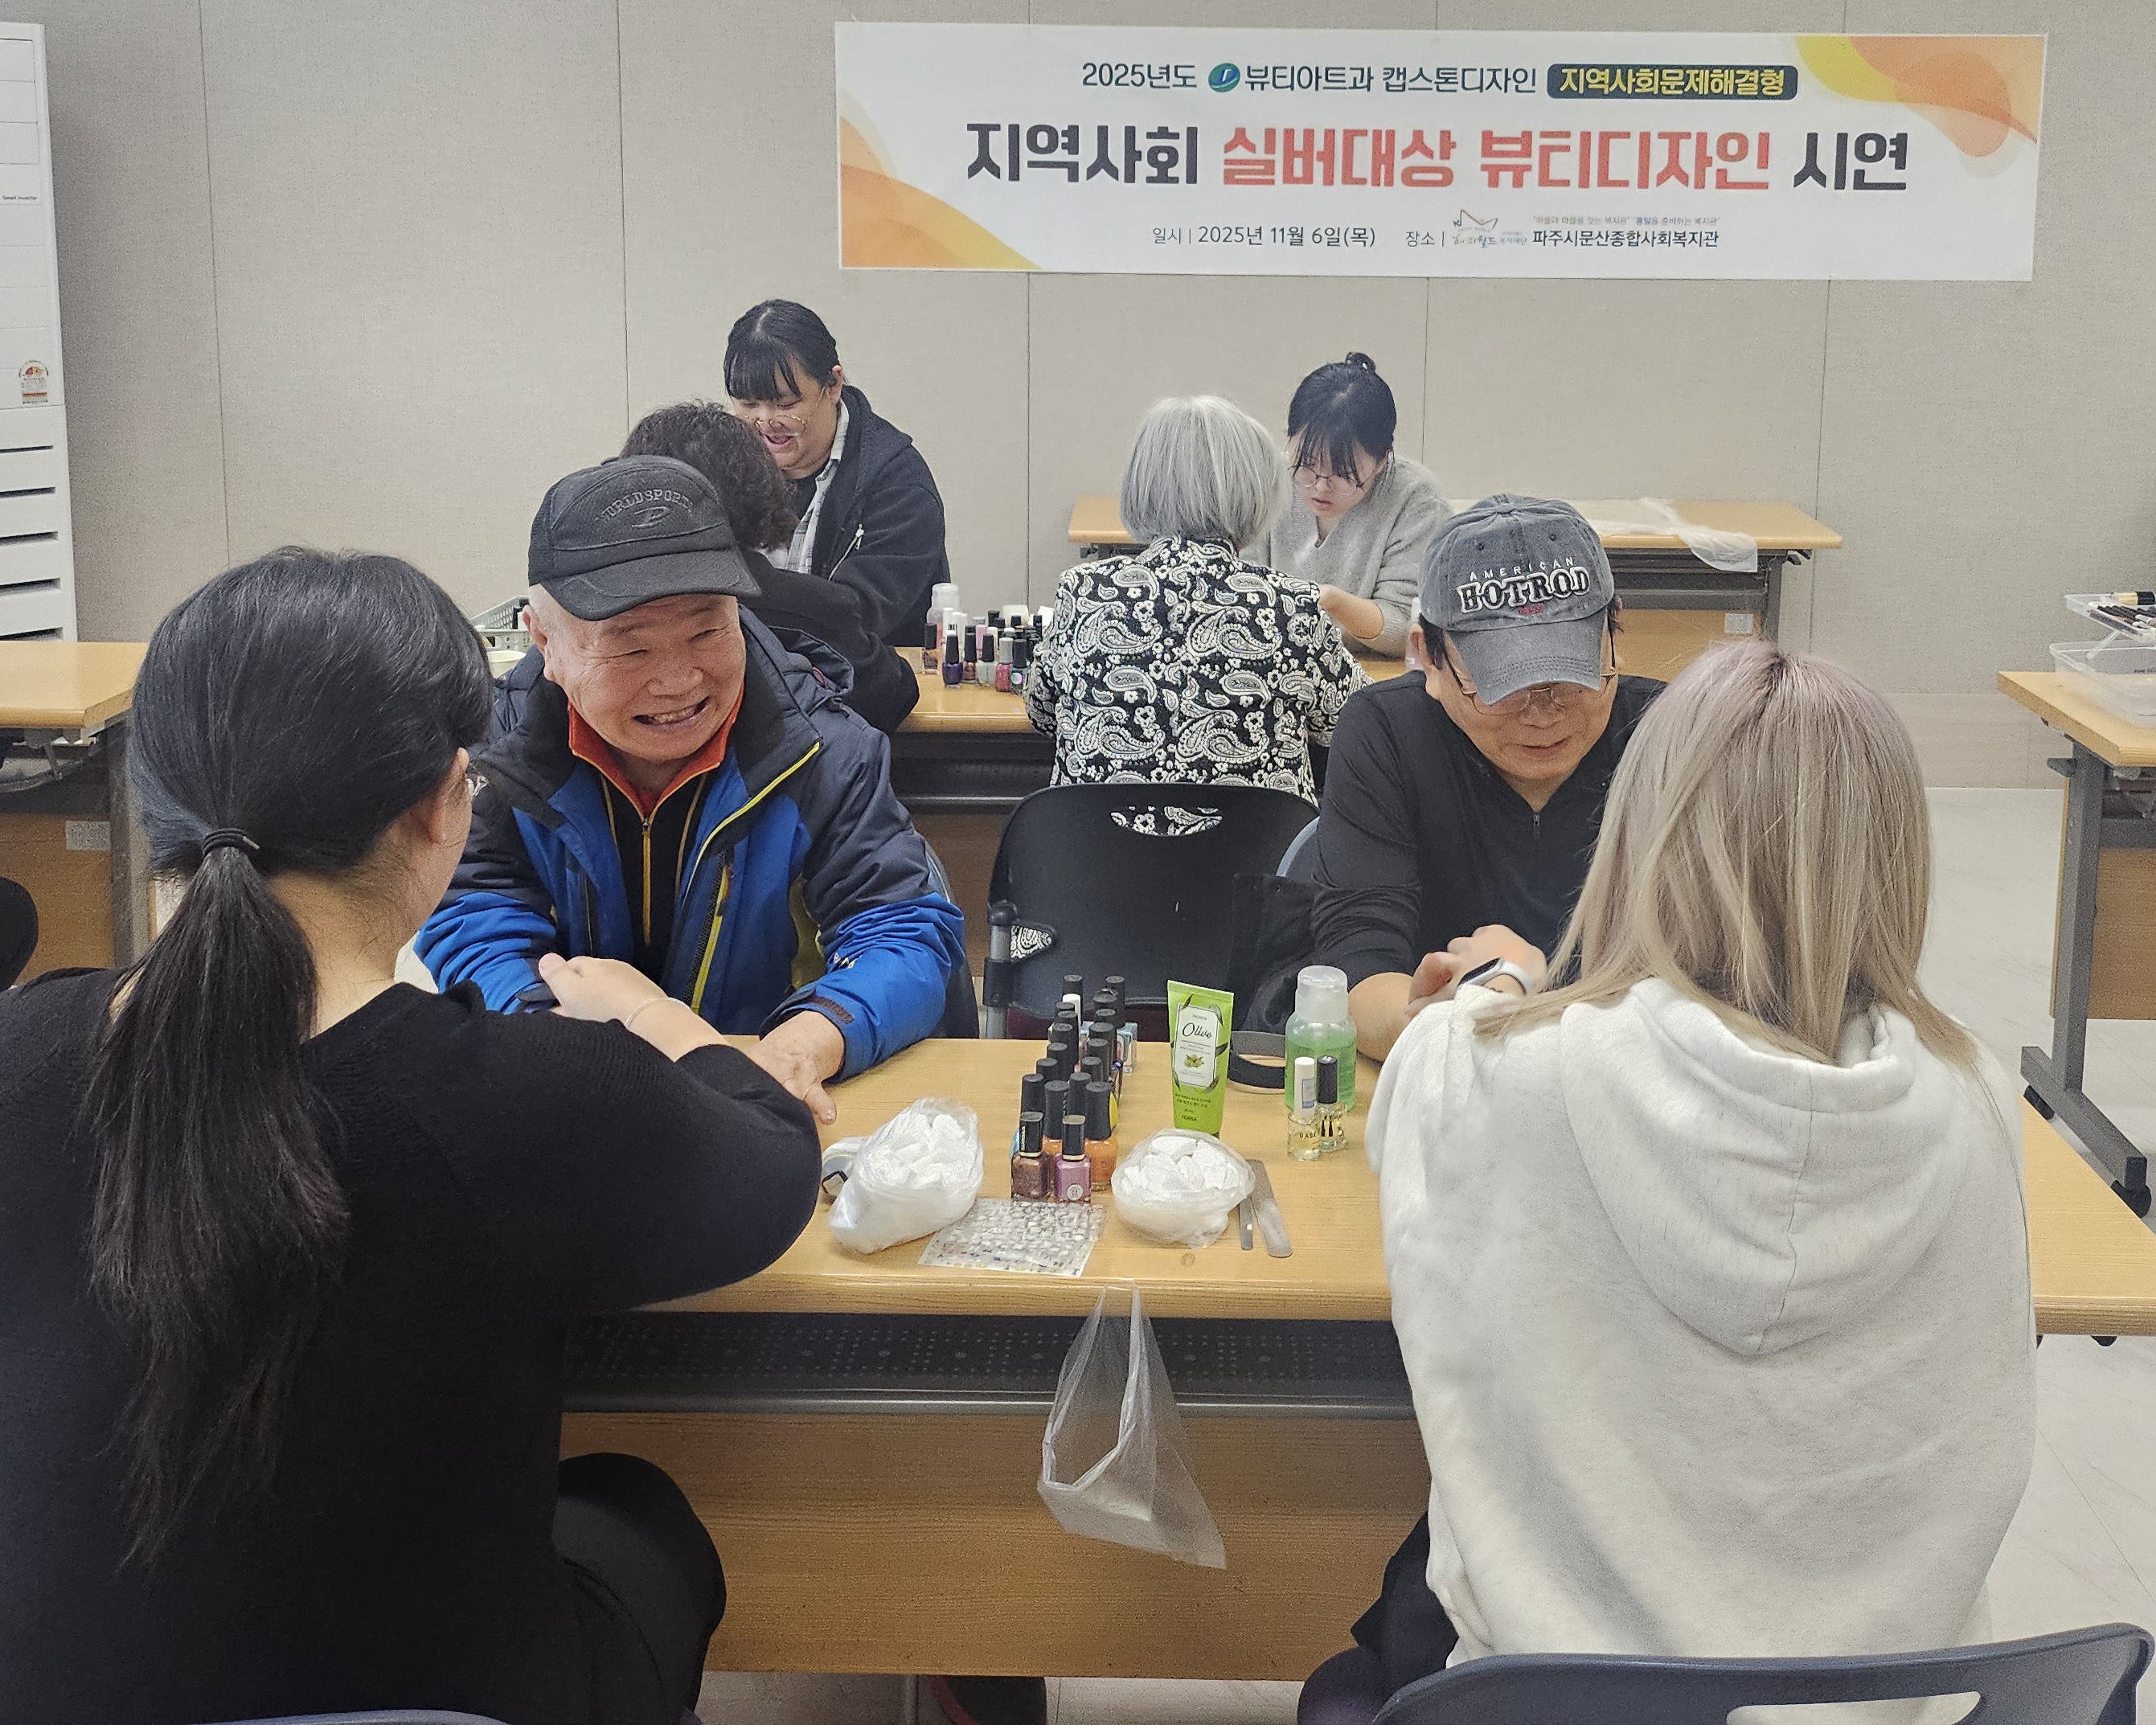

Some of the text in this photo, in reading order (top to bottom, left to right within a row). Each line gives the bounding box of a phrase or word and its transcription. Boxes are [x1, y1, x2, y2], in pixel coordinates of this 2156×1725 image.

[1082, 62, 1785, 96] 2025년도 뷰티아트과 캡스톤디자인 지역사회문제해결형
[966, 123, 1908, 191] 지역사회 실버대상 뷰티디자인 시연
[1153, 226, 1375, 248] 일시 2025년 11월 6일(목)
[1406, 231, 1436, 248] 장소
[1531, 230, 1719, 248] 파주시문산종합사회복지관
[1469, 556, 1575, 582] AMERICAN
[1456, 566, 1591, 613] HOTROD
[1182, 1022, 1213, 1039] Olive
